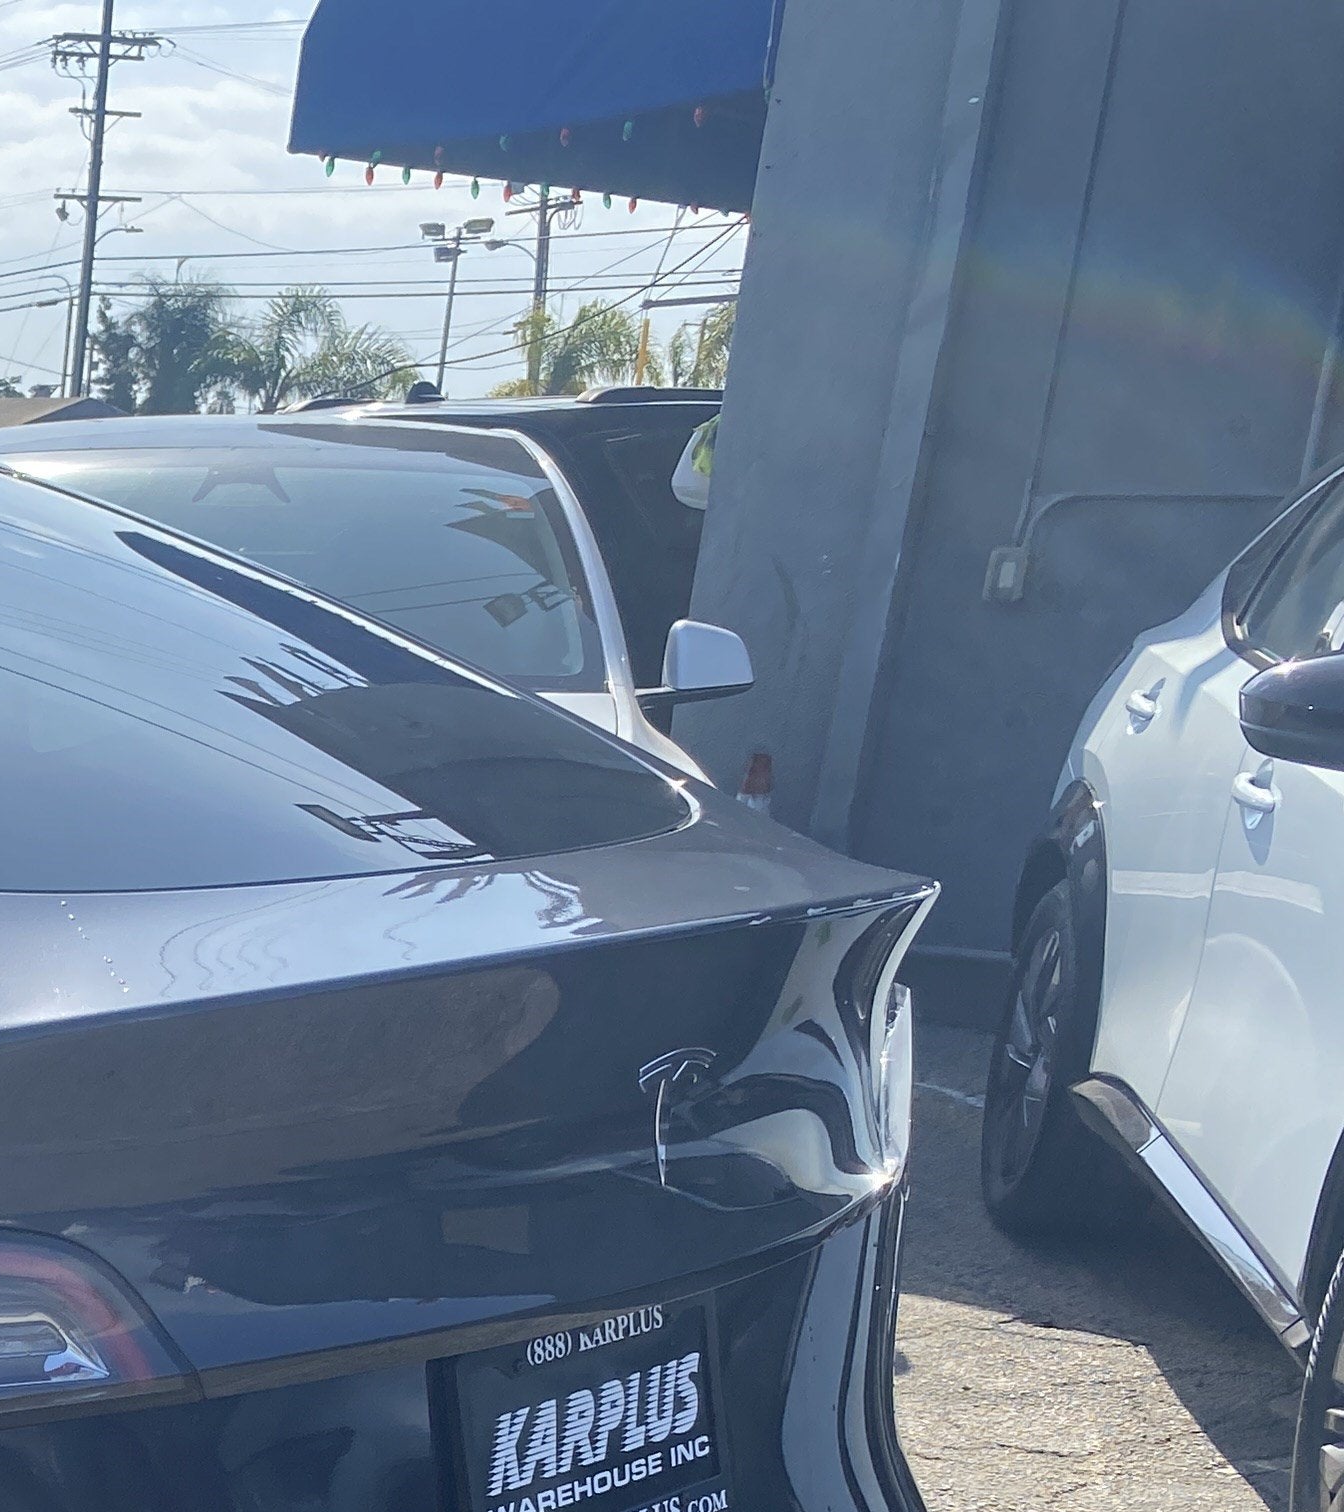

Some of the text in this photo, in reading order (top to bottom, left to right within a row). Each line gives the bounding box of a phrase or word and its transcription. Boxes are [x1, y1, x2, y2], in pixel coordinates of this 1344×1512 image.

[526, 1331, 572, 1366] (888)
[485, 1351, 701, 1497] KARPLUS
[670, 1435, 710, 1467] INC
